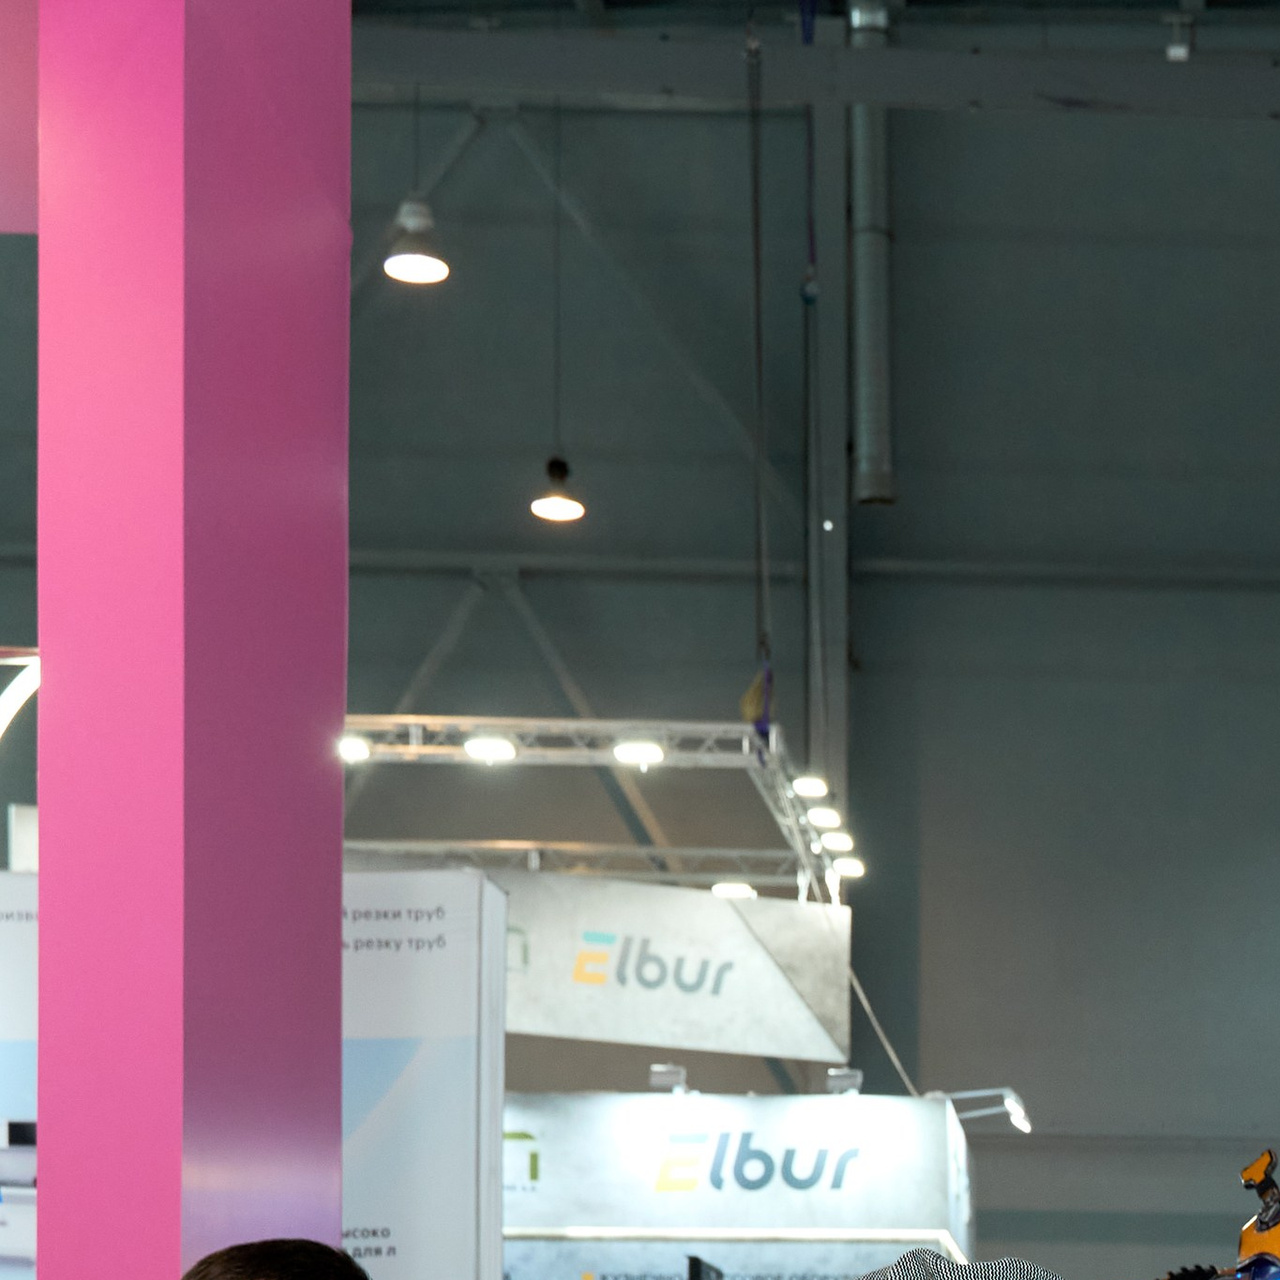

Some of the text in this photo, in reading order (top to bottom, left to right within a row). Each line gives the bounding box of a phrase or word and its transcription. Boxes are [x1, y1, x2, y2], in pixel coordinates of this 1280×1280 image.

[353, 908, 402, 923] резки
[407, 905, 445, 923] труб
[407, 933, 447, 952] труб
[572, 930, 733, 996] Elbur
[655, 1132, 860, 1192] Elbur
